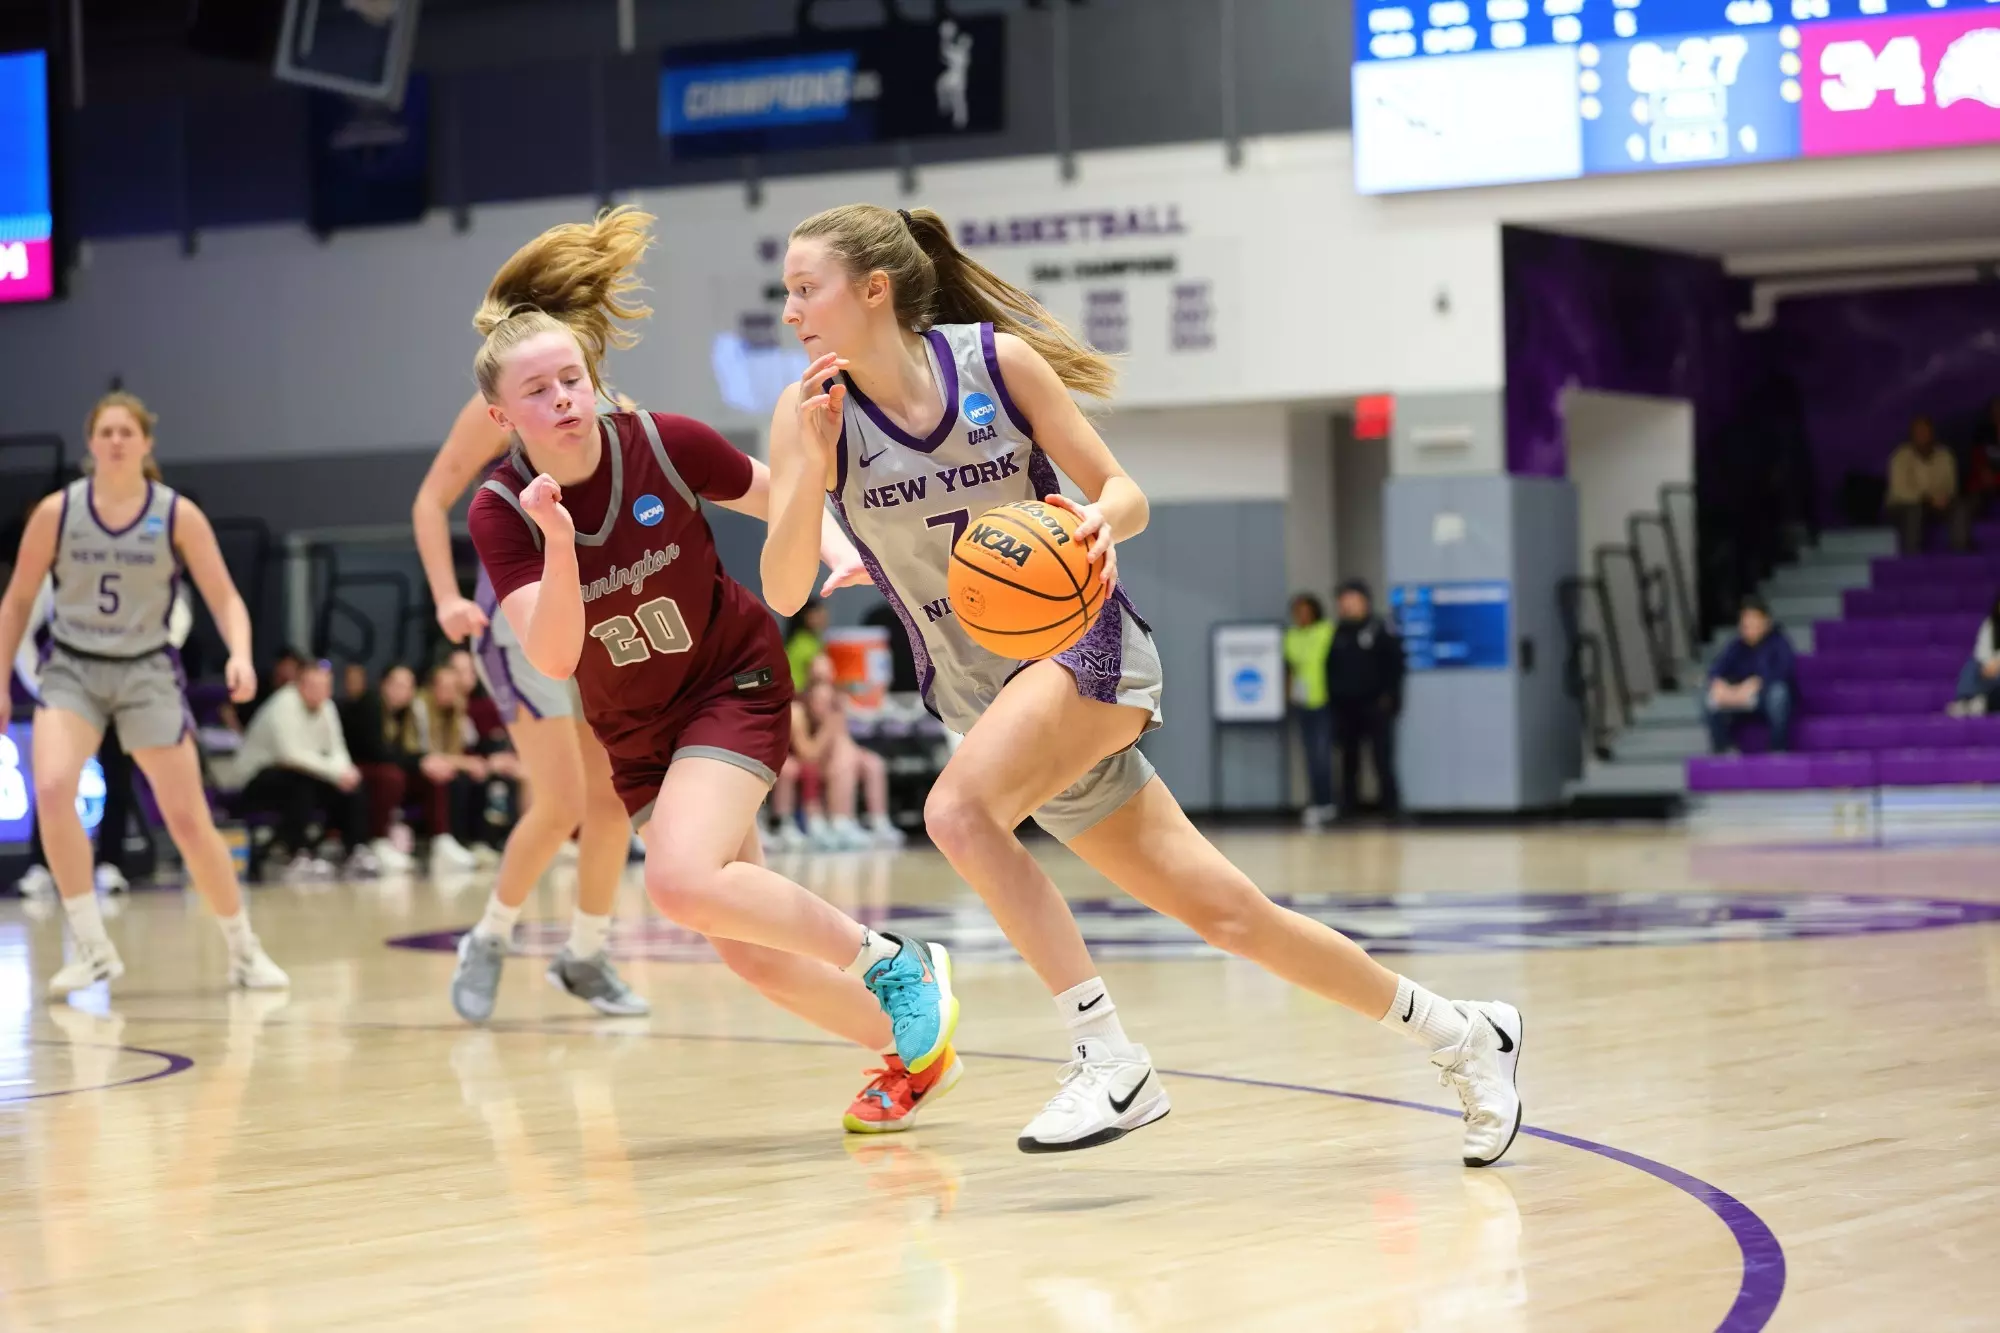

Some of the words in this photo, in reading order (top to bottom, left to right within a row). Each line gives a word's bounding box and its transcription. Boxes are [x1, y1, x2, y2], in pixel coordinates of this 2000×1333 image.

[1820, 36, 1925, 111] 34
[960, 206, 1186, 246] BASKETBALL
[970, 404, 995, 419] NCAA
[967, 425, 998, 446] UAA
[863, 475, 927, 509] NEW
[936, 452, 1020, 493] YORK
[639, 504, 664, 522] NCAA
[923, 507, 972, 556] 7
[966, 523, 1033, 567] NCAA
[99, 574, 120, 615] 5
[589, 596, 693, 667] 20
